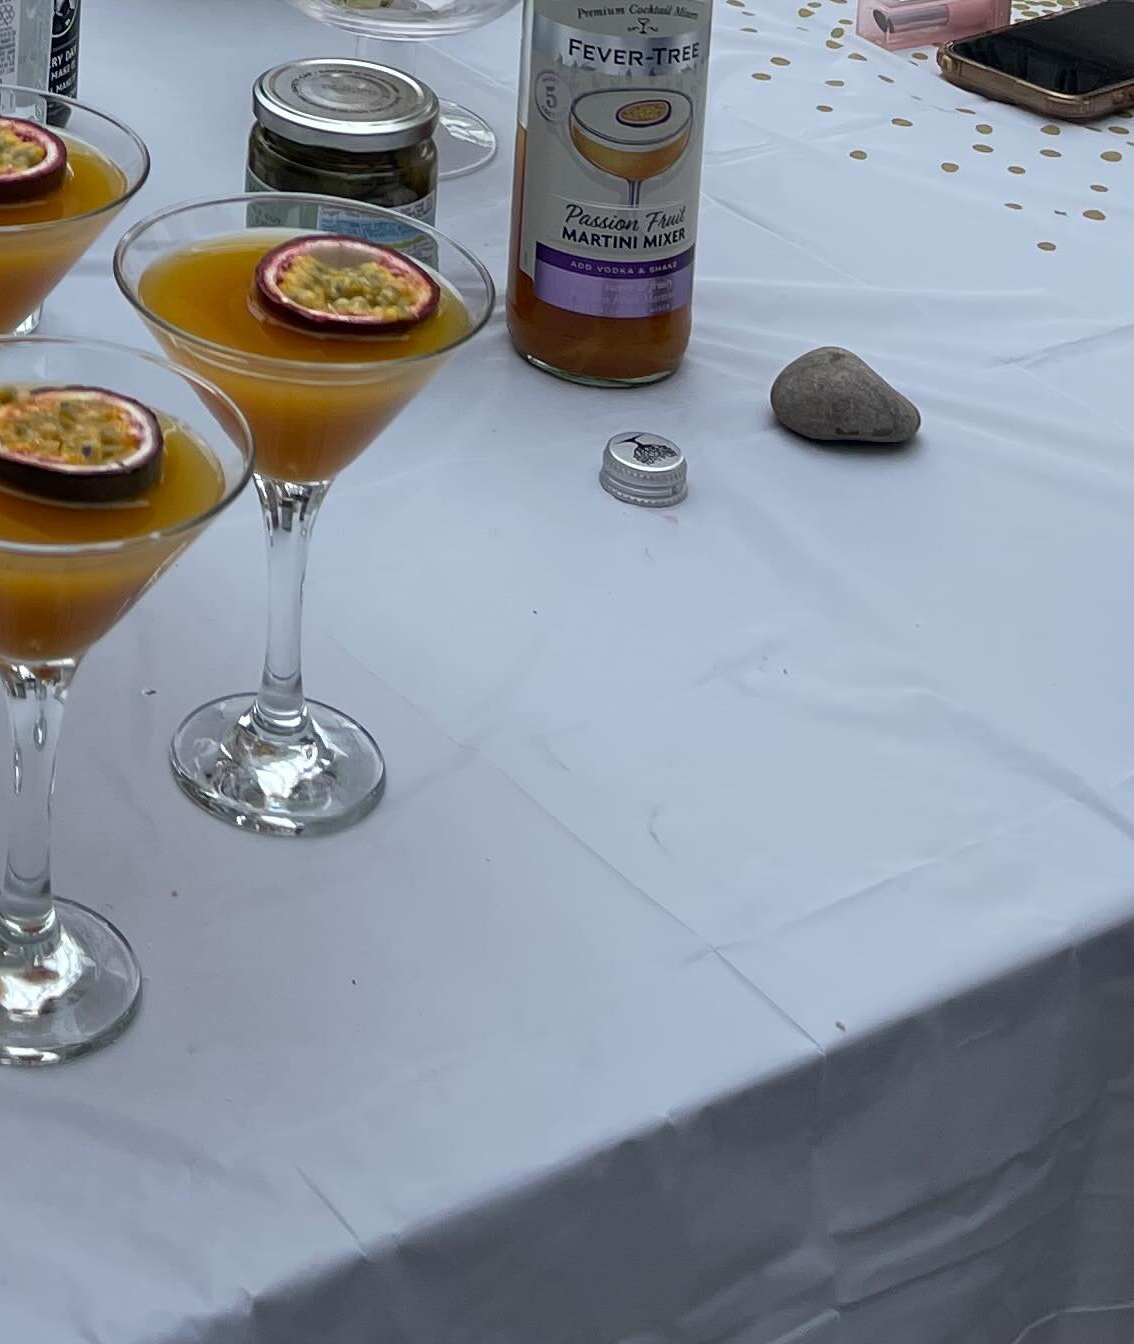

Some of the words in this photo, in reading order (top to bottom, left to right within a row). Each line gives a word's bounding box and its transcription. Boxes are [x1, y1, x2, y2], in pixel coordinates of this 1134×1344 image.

[577, 6, 625, 20] Premium
[628, 3, 672, 16] Cocktail
[568, 38, 700, 66] FEVER-TREE
[565, 203, 640, 232] Passion
[646, 205, 686, 233] Fruit
[562, 226, 638, 249] MARTINI
[643, 227, 686, 249] MIXER
[570, 260, 593, 271] ADD
[597, 265, 635, 274] VODKA
